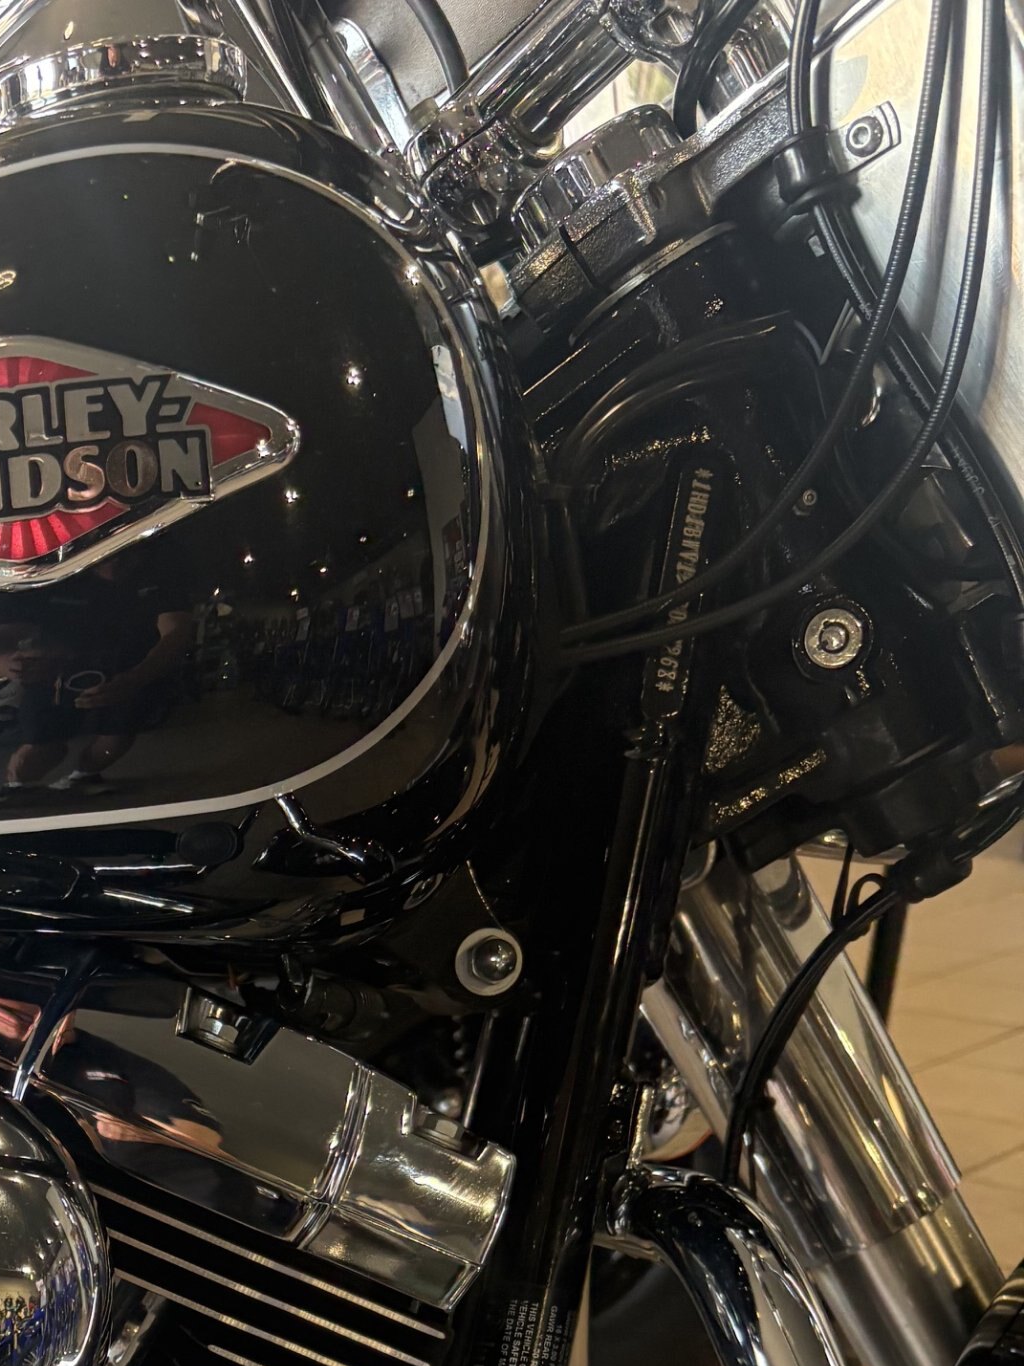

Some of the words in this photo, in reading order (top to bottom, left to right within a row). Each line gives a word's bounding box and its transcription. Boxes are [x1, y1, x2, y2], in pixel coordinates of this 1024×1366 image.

[506, 1297, 518, 1316] THE
[513, 1298, 528, 1338] VEHICLE
[527, 1301, 538, 1322] THIS
[545, 1304, 558, 1333] GAWR
[501, 1317, 514, 1342] DATE
[519, 1322, 534, 1362] VEHICLE
[499, 1342, 509, 1356] OF
[540, 1333, 552, 1359] REAR
